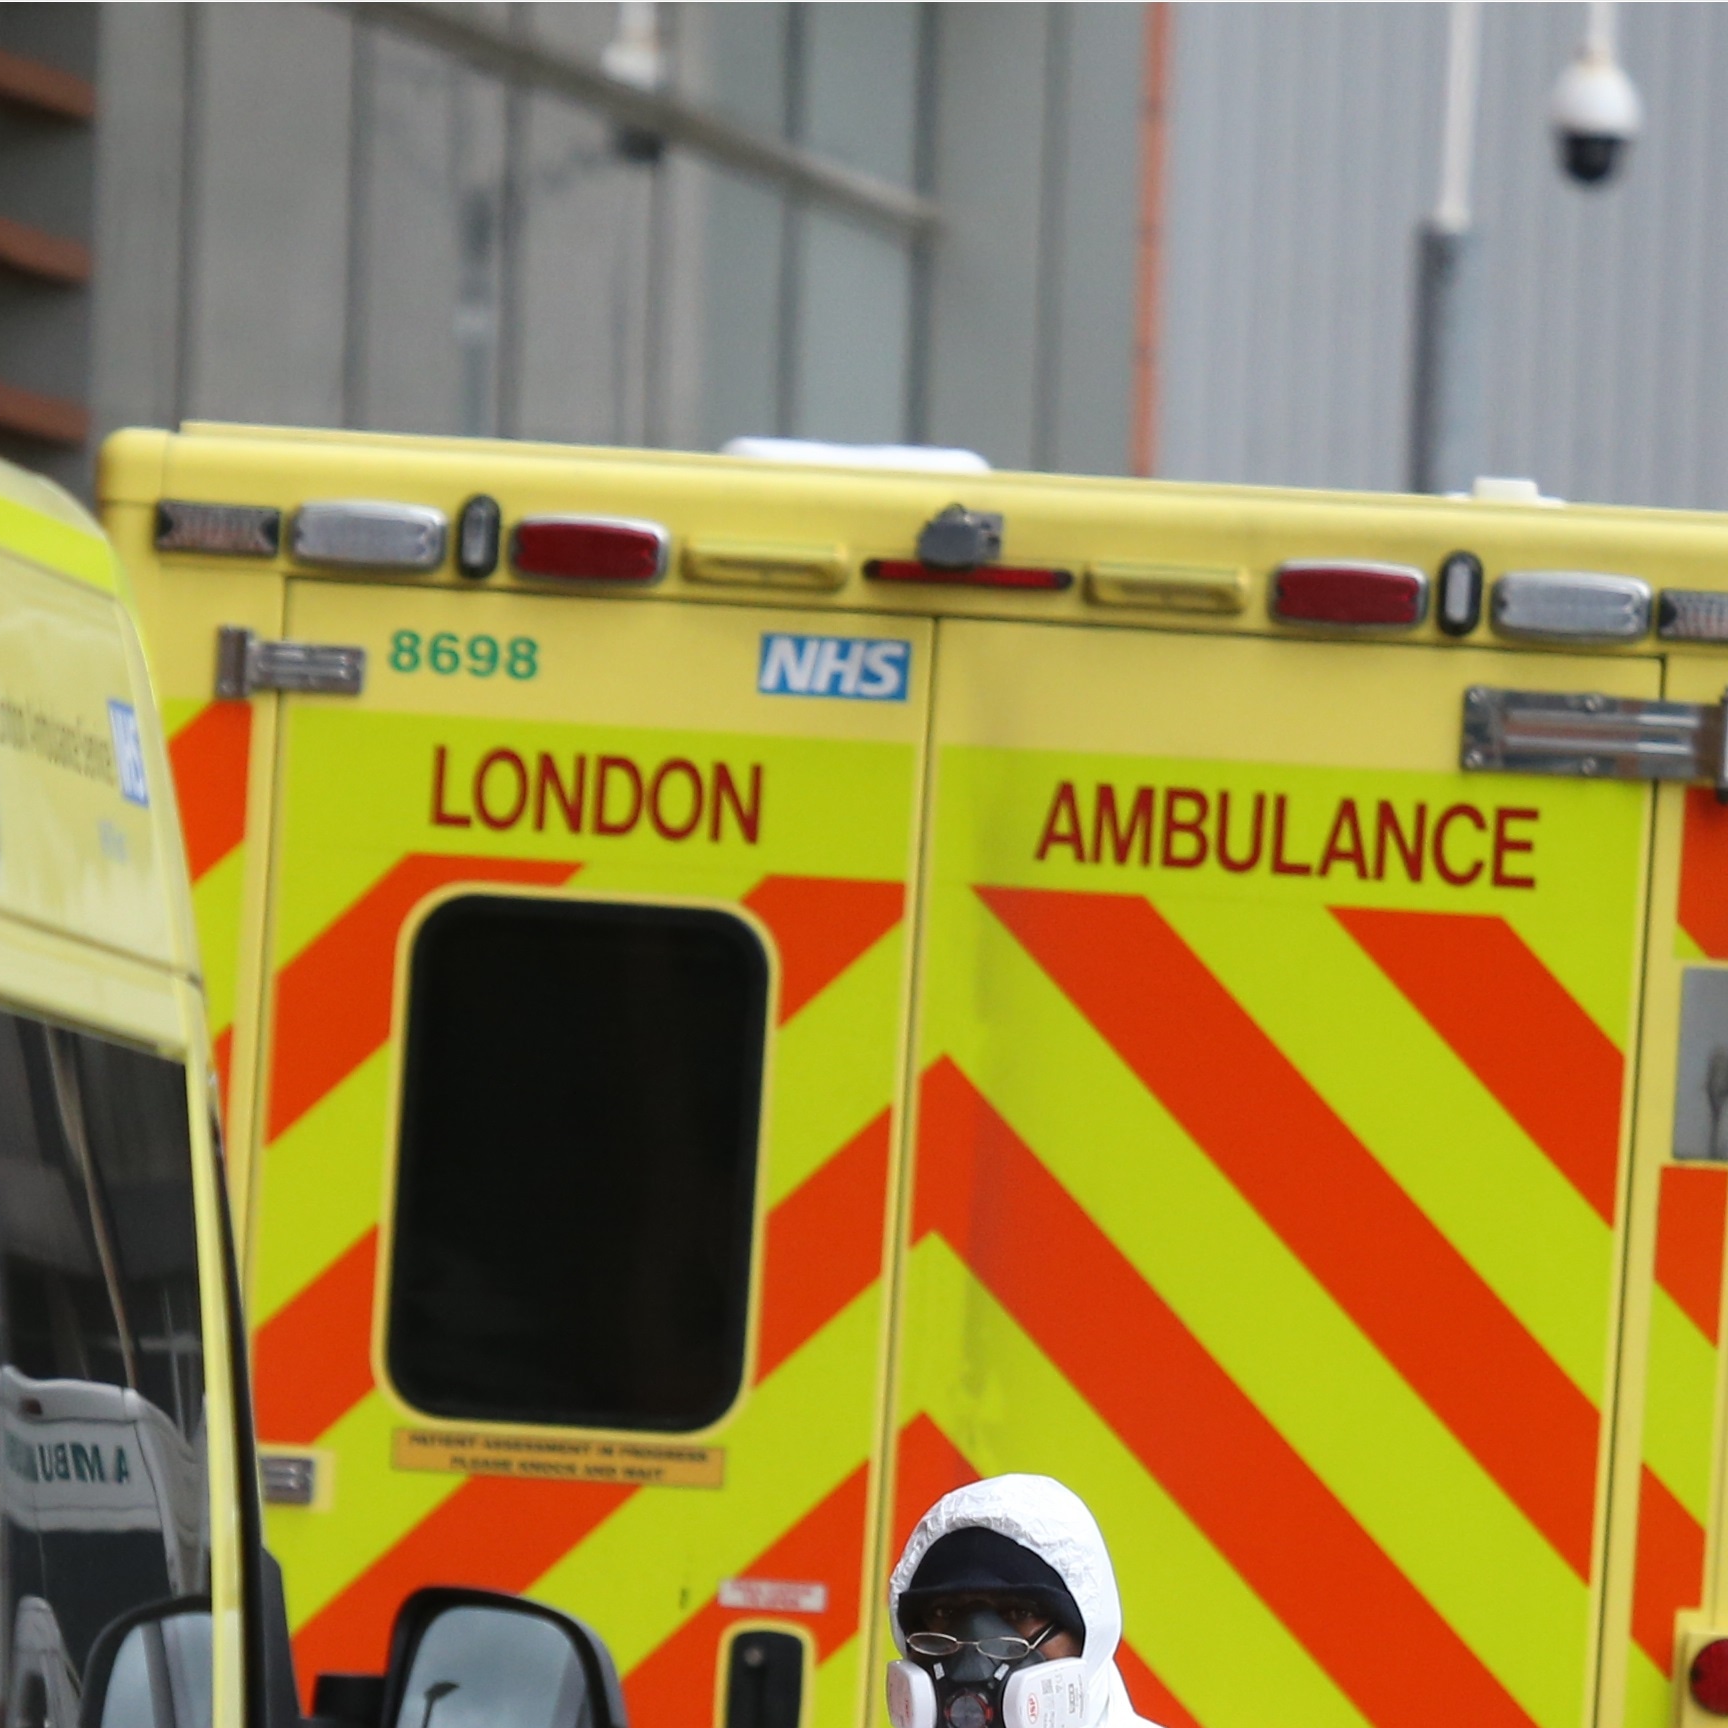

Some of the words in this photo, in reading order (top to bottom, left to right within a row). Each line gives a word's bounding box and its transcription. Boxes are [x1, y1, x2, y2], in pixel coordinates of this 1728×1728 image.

[388, 629, 540, 680] 8698
[761, 637, 904, 697] NHS
[429, 744, 765, 846] LONDON
[1034, 780, 1540, 889] AMBULANCE
